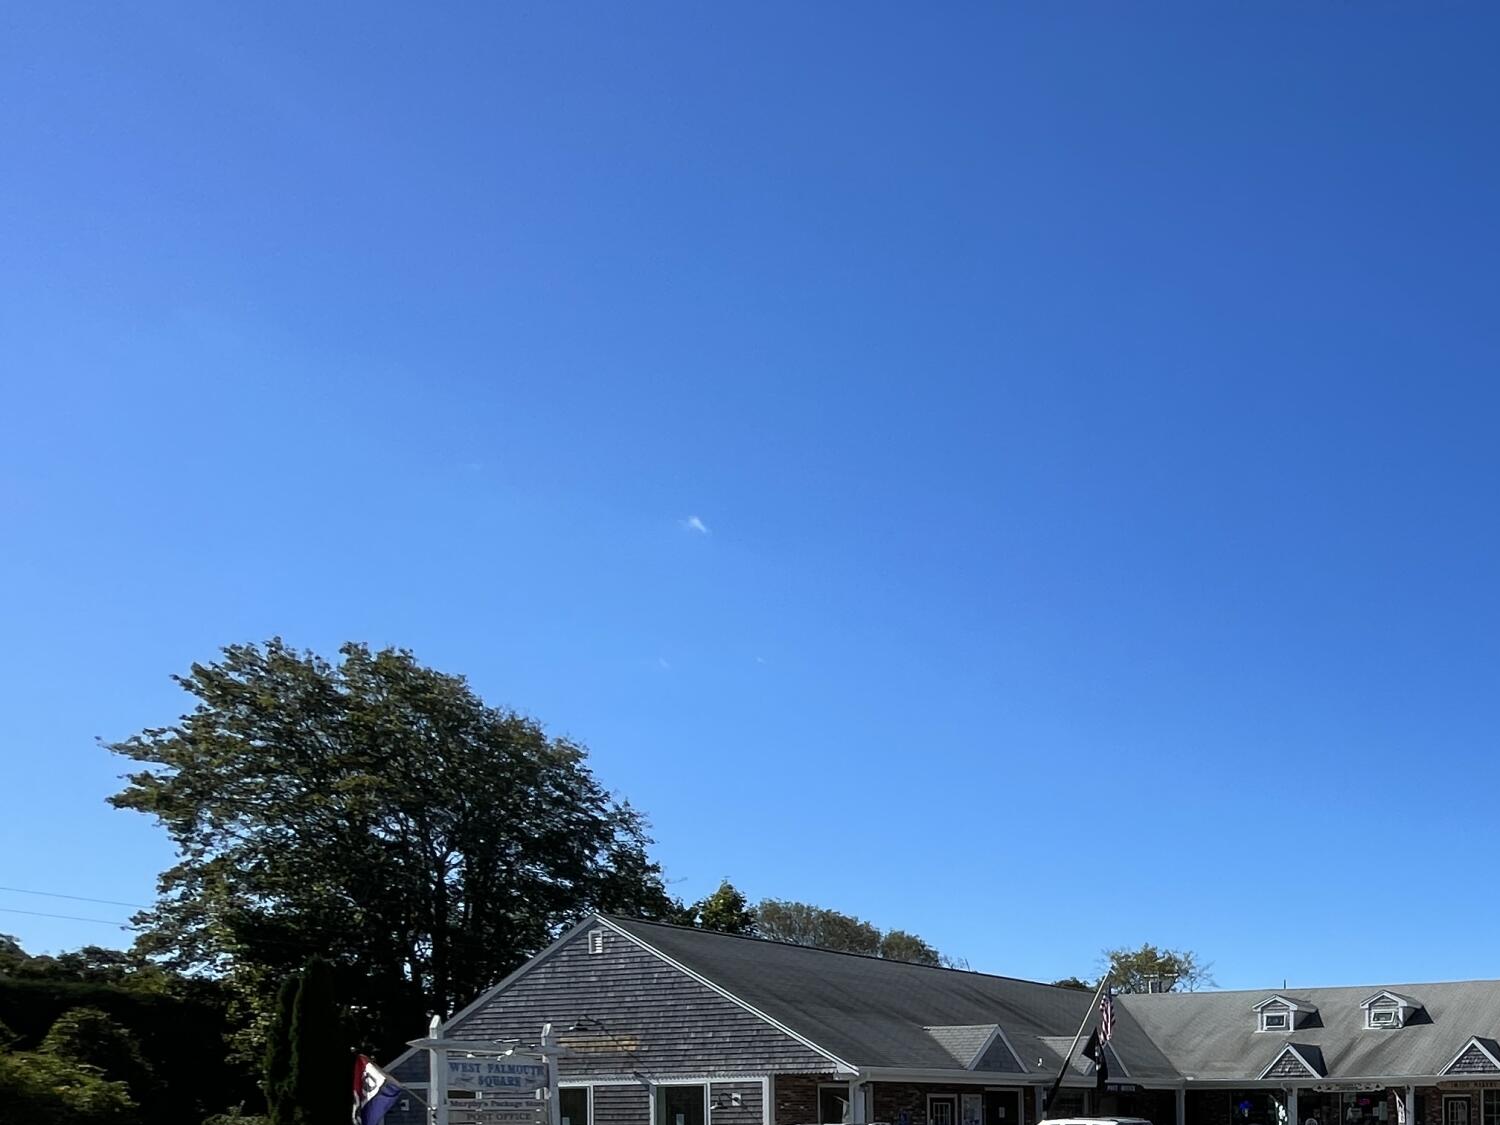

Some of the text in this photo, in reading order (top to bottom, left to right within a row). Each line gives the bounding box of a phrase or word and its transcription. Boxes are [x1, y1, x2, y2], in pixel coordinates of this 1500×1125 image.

[448, 1062, 545, 1075] WEST FALMOUTH
[478, 1076, 521, 1087] SQUARE
[496, 1112, 531, 1120] OFFICE
